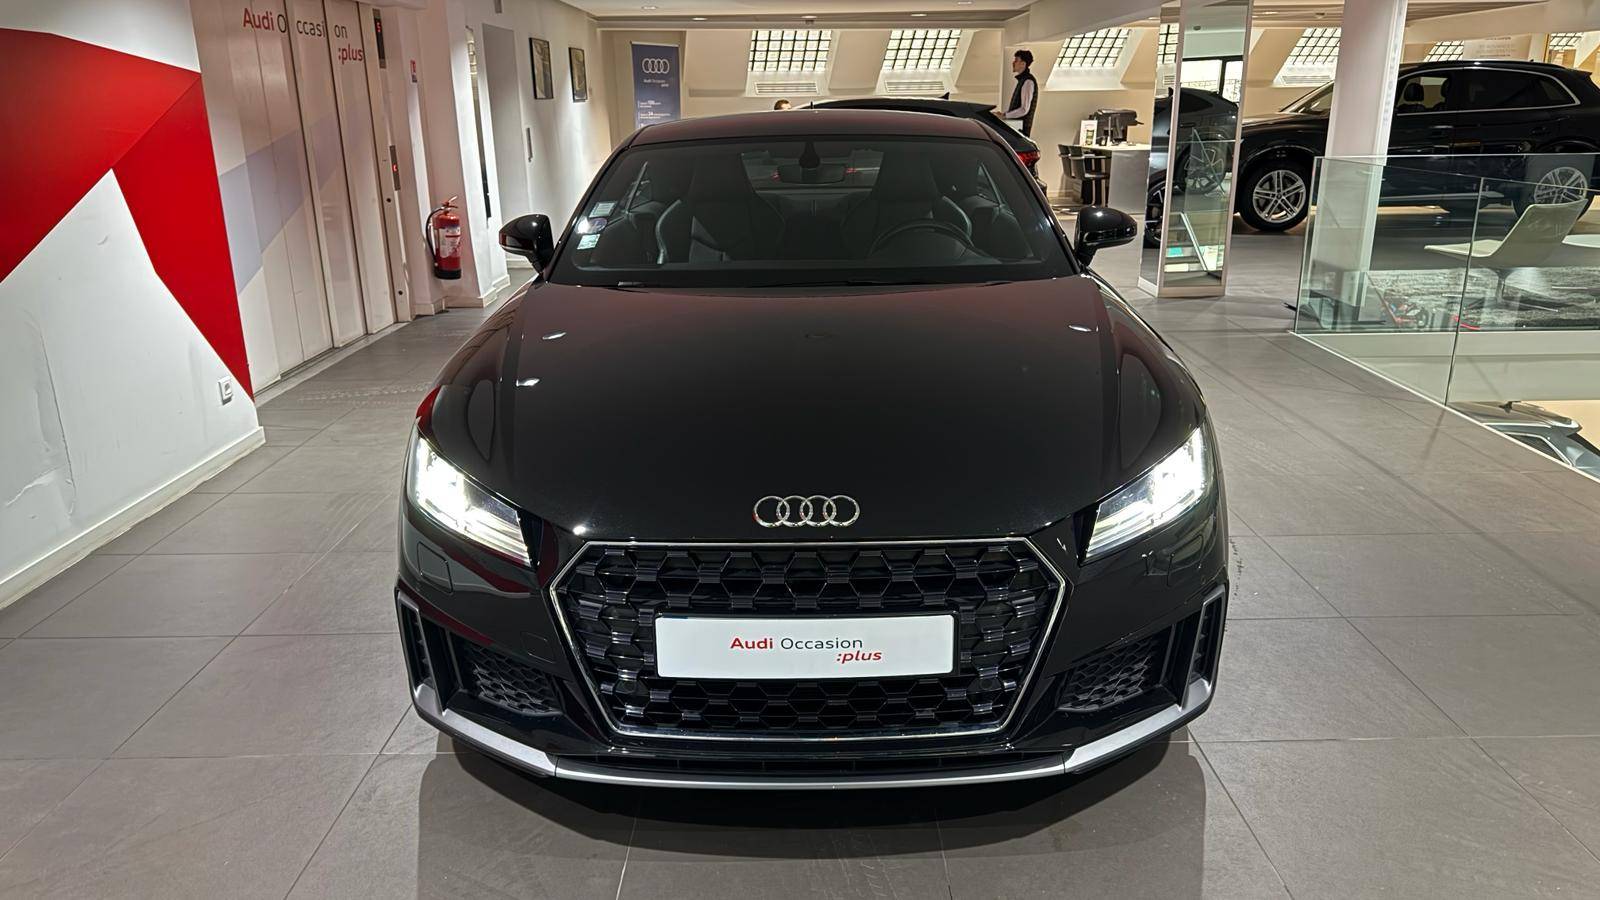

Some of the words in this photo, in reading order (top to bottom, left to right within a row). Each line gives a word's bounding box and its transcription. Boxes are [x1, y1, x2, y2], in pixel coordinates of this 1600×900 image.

[243, 8, 274, 31] Audi
[338, 44, 364, 65] :plus
[730, 638, 773, 650] Audi
[780, 637, 863, 650] Occasion
[836, 650, 882, 664] :plus
